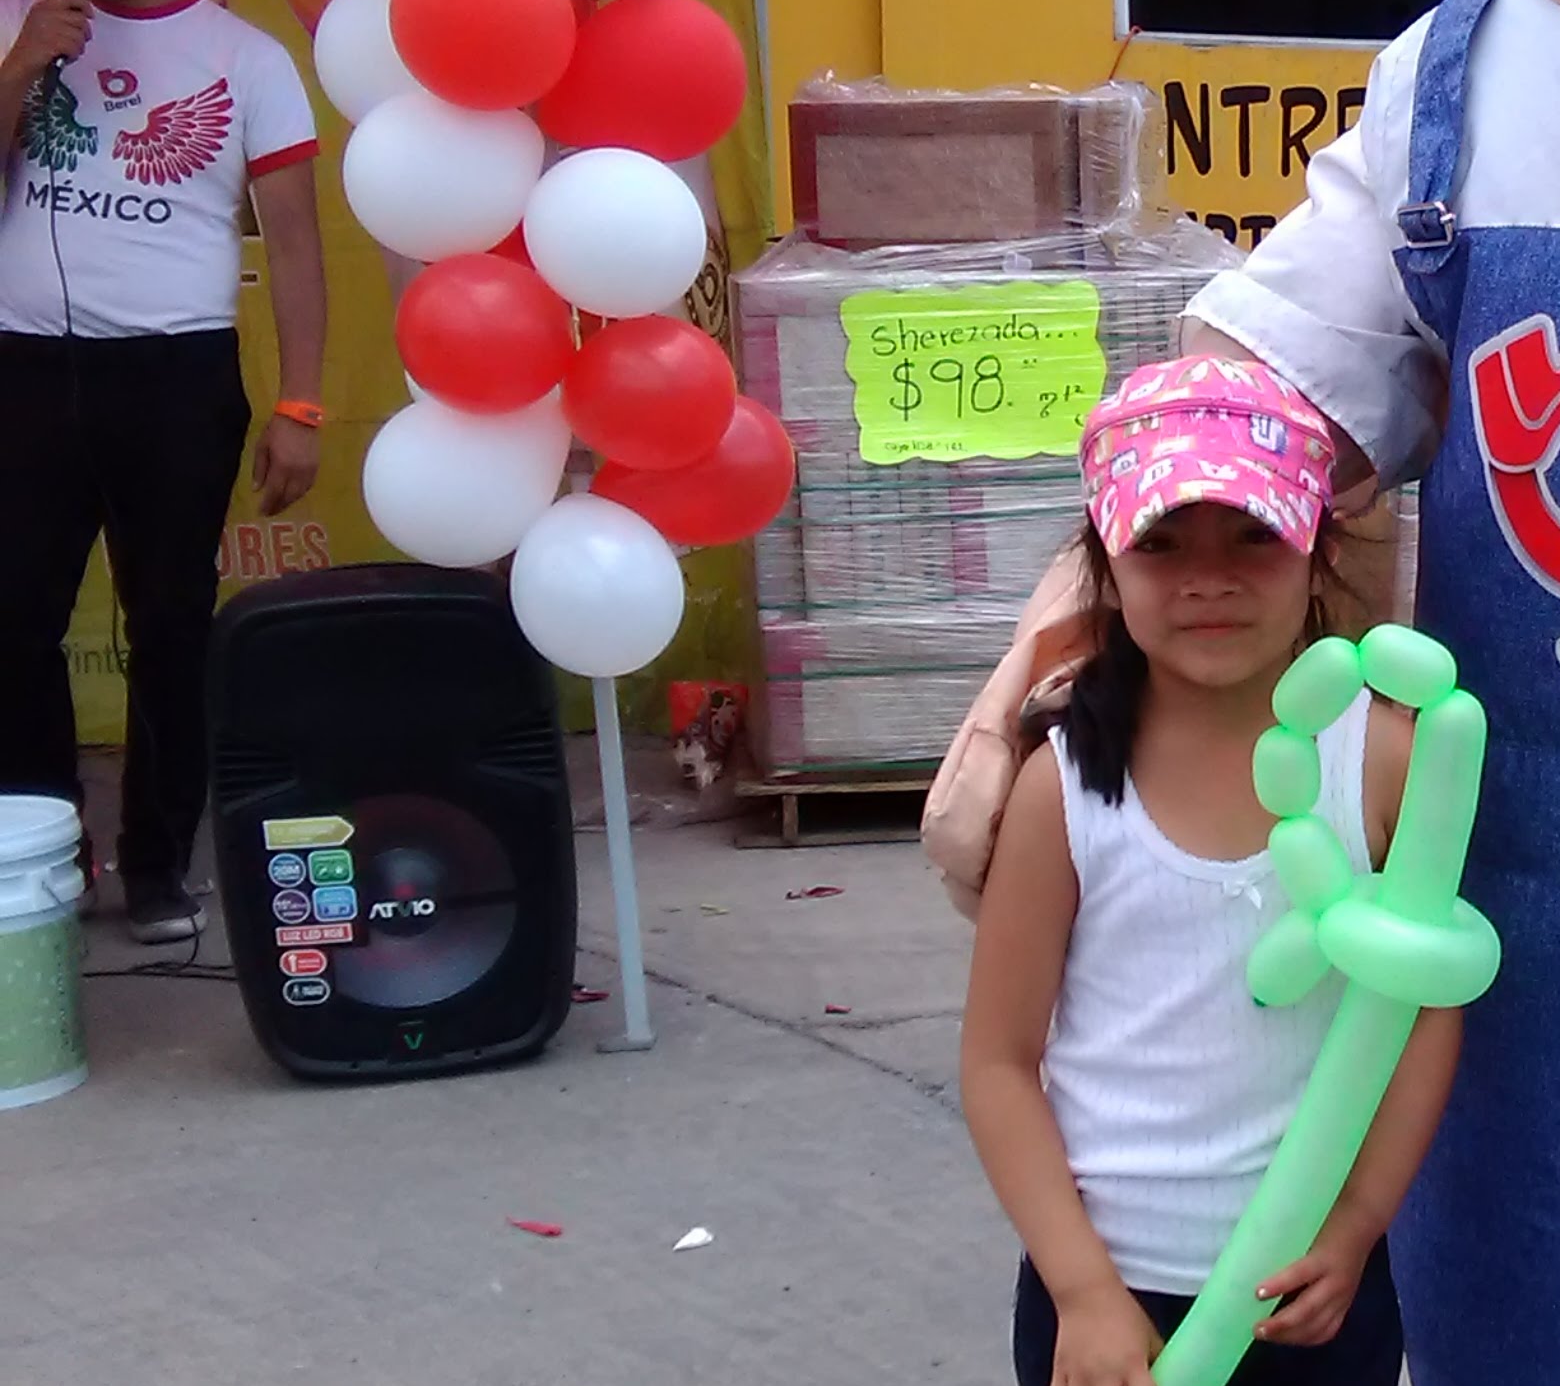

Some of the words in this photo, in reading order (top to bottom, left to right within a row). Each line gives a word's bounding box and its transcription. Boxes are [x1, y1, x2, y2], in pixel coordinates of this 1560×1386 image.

[103, 95, 142, 113] Berel
[25, 179, 172, 224] MÉXICO
[369, 898, 436, 920] ATVIO
